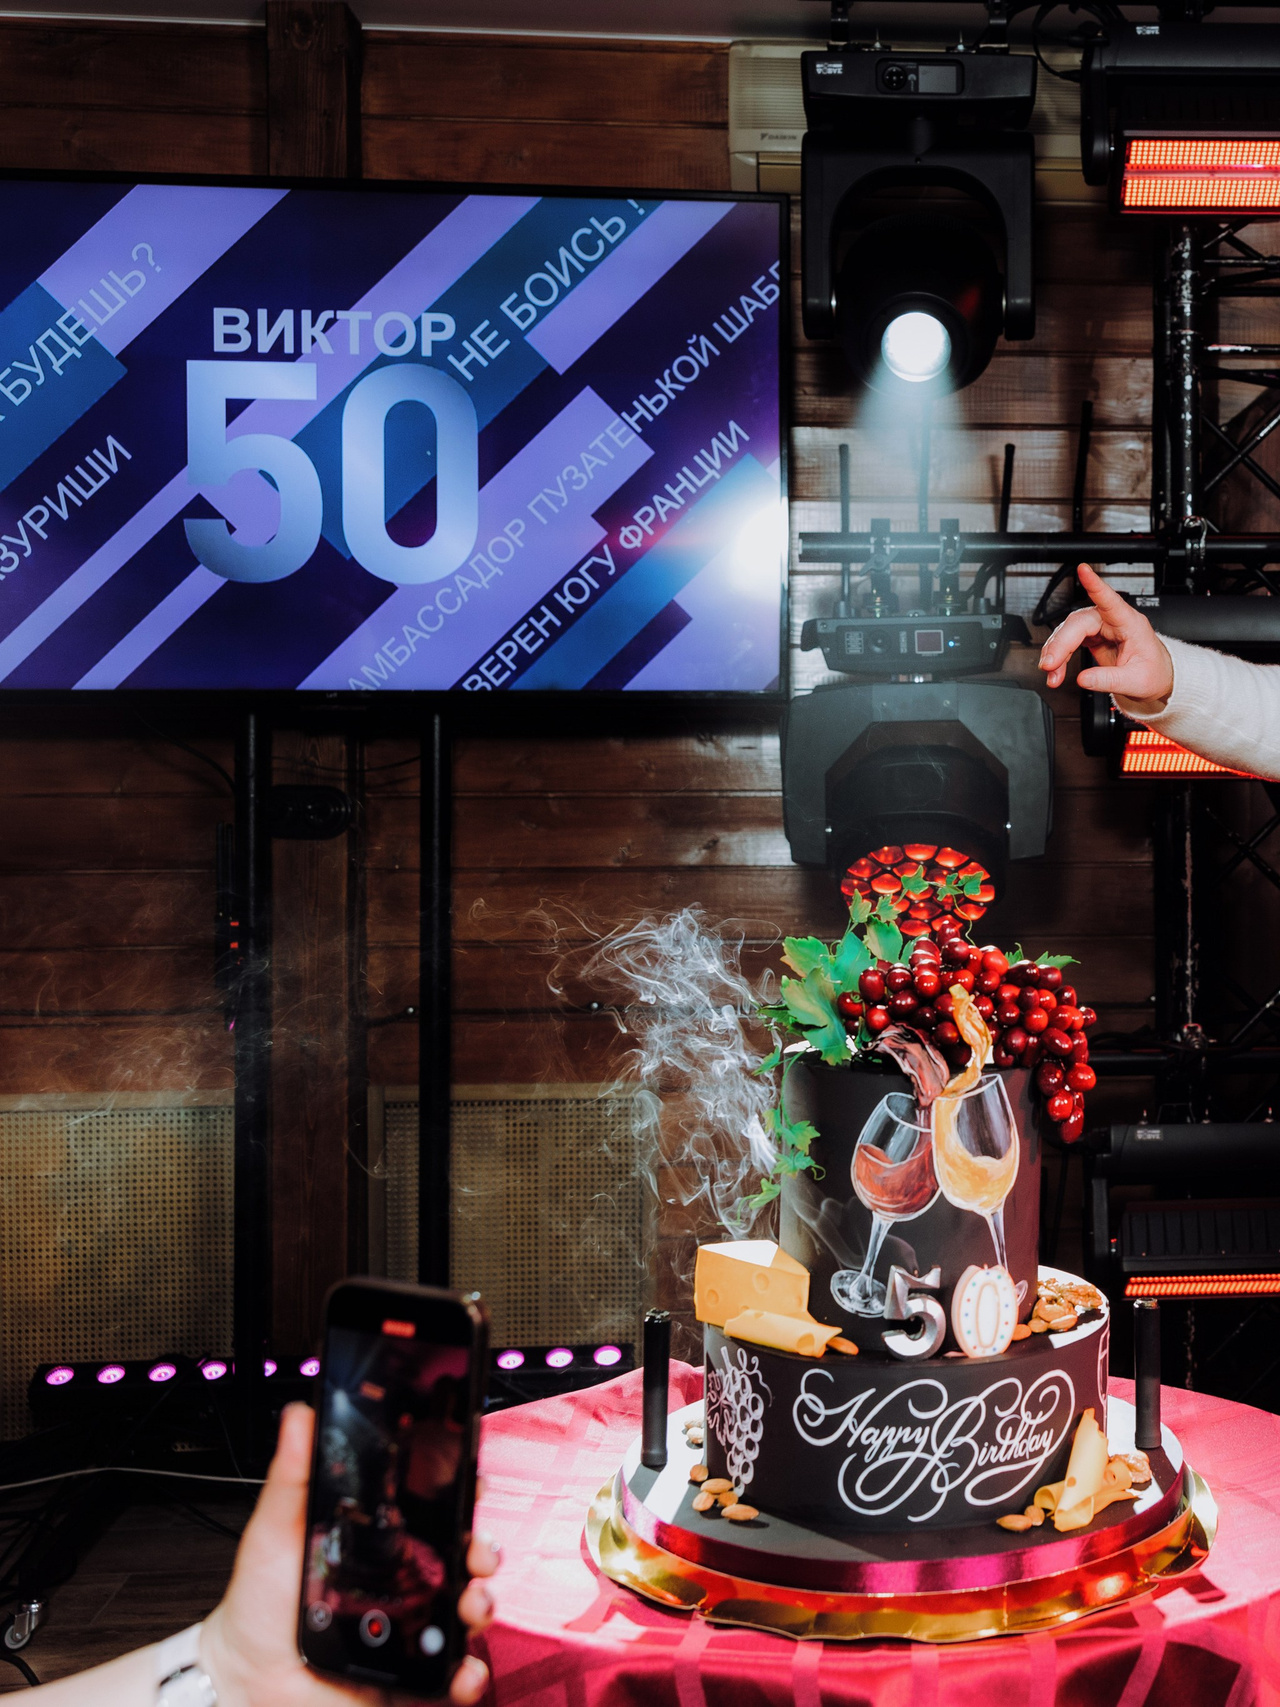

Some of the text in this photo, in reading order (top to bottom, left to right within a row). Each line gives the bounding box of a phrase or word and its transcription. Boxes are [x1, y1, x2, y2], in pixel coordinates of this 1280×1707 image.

[0, 242, 162, 406] БУДЕШЬ?
[213, 307, 457, 357] ВИКТОР
[447, 319, 511, 382] НЕ
[500, 216, 627, 331] БОИСЬ
[0, 434, 132, 581] ЗУРИШИ
[183, 359, 479, 585] 50
[526, 334, 721, 525] ПУЗАТЕНЬКОЙ
[553, 543, 616, 614] ЮГУ
[618, 419, 750, 549] ФРАНЦИИ
[881, 1263, 1019, 1361] 50
[793, 1368, 1075, 1522] Happy Birthday
